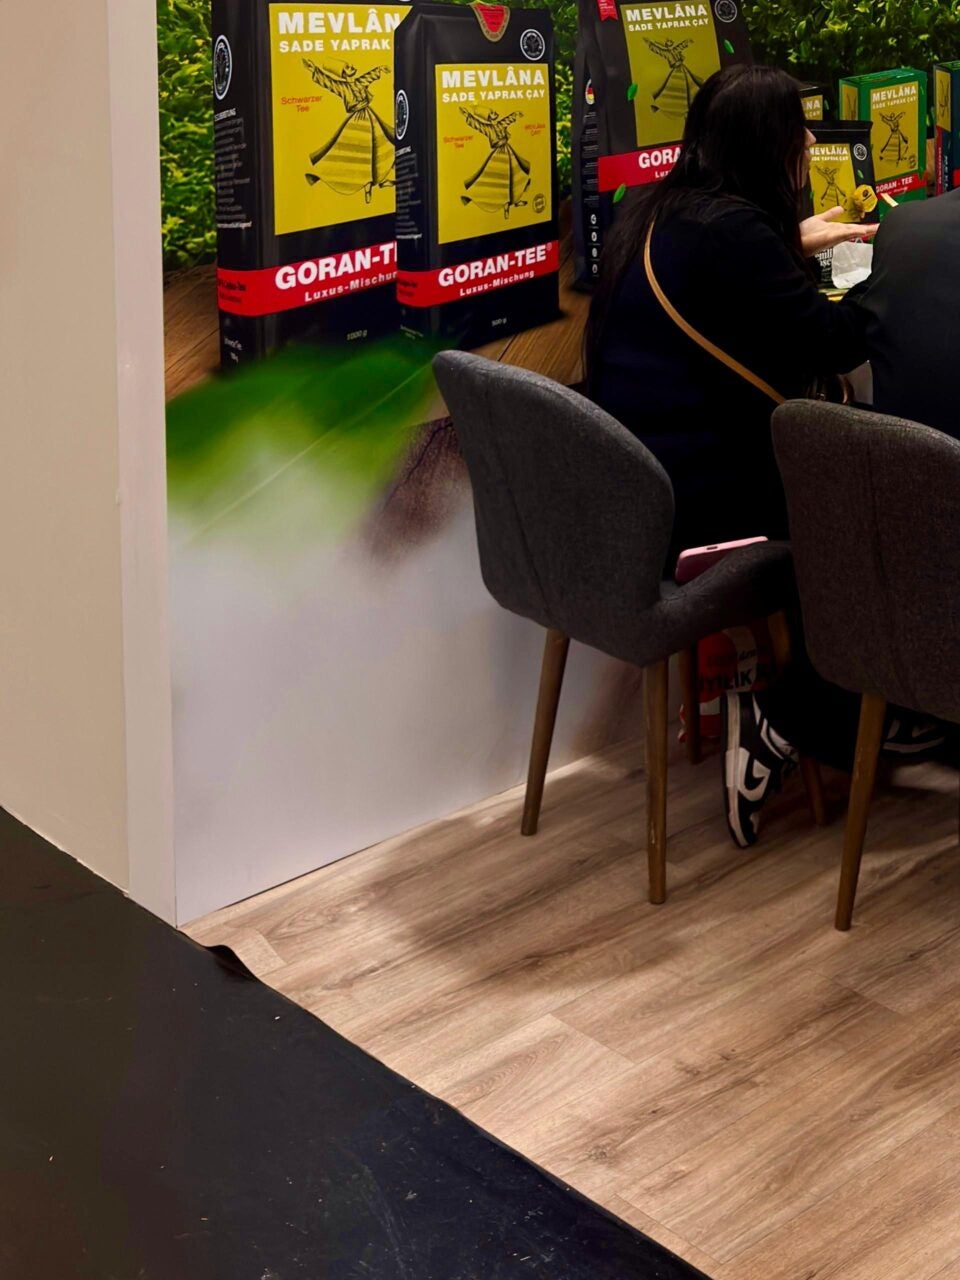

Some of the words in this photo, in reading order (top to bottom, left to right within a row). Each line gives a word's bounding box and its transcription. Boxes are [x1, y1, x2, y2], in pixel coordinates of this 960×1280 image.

[279, 8, 400, 35] MEVLÂN
[626, 4, 708, 22] MEVLÂNA
[628, 22, 653, 32] SADE
[656, 20, 691, 30] YAPRAK
[692, 18, 709, 27] ÇAY
[279, 40, 324, 53] SADE
[331, 39, 391, 51] YAPRAK
[442, 66, 545, 88] MEVLÂNA
[281, 94, 322, 105] Schwarzer
[442, 92, 475, 103] SADE
[480, 90, 524, 101] YAPRAK
[526, 89, 545, 101] ÇAY
[872, 85, 917, 102] MEVLÂNA
[296, 104, 310, 113] Tee
[275, 241, 397, 290] GORAN-T
[460, 270, 535, 297] Luxus-Mischung
